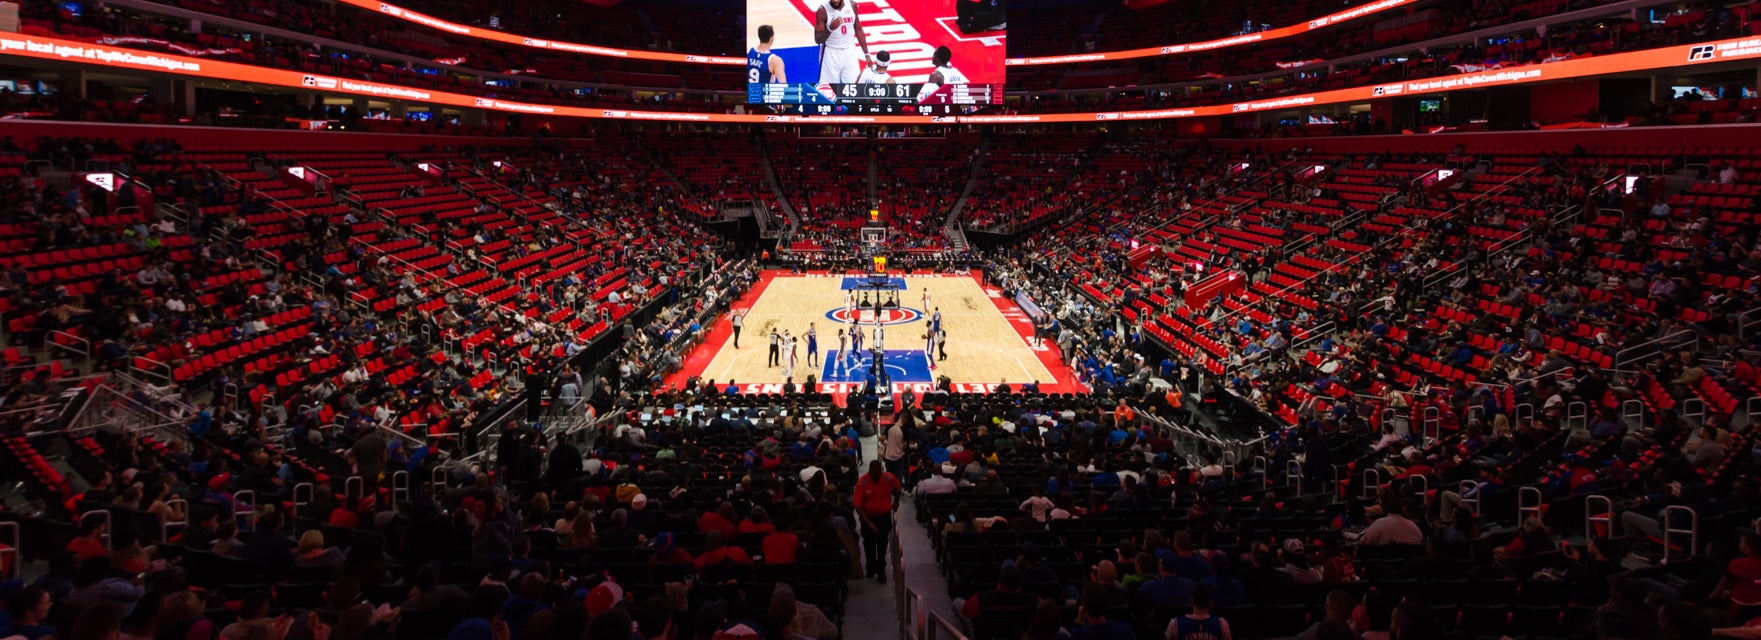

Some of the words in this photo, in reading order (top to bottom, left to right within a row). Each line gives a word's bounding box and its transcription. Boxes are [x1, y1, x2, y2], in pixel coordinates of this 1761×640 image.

[840, 25, 847, 35] 0
[26, 40, 54, 54] local
[54, 45, 84, 57] agent
[84, 49, 96, 59] at
[842, 84, 858, 97] 45
[868, 87, 886, 97] 9:09
[896, 84, 910, 97] 61
